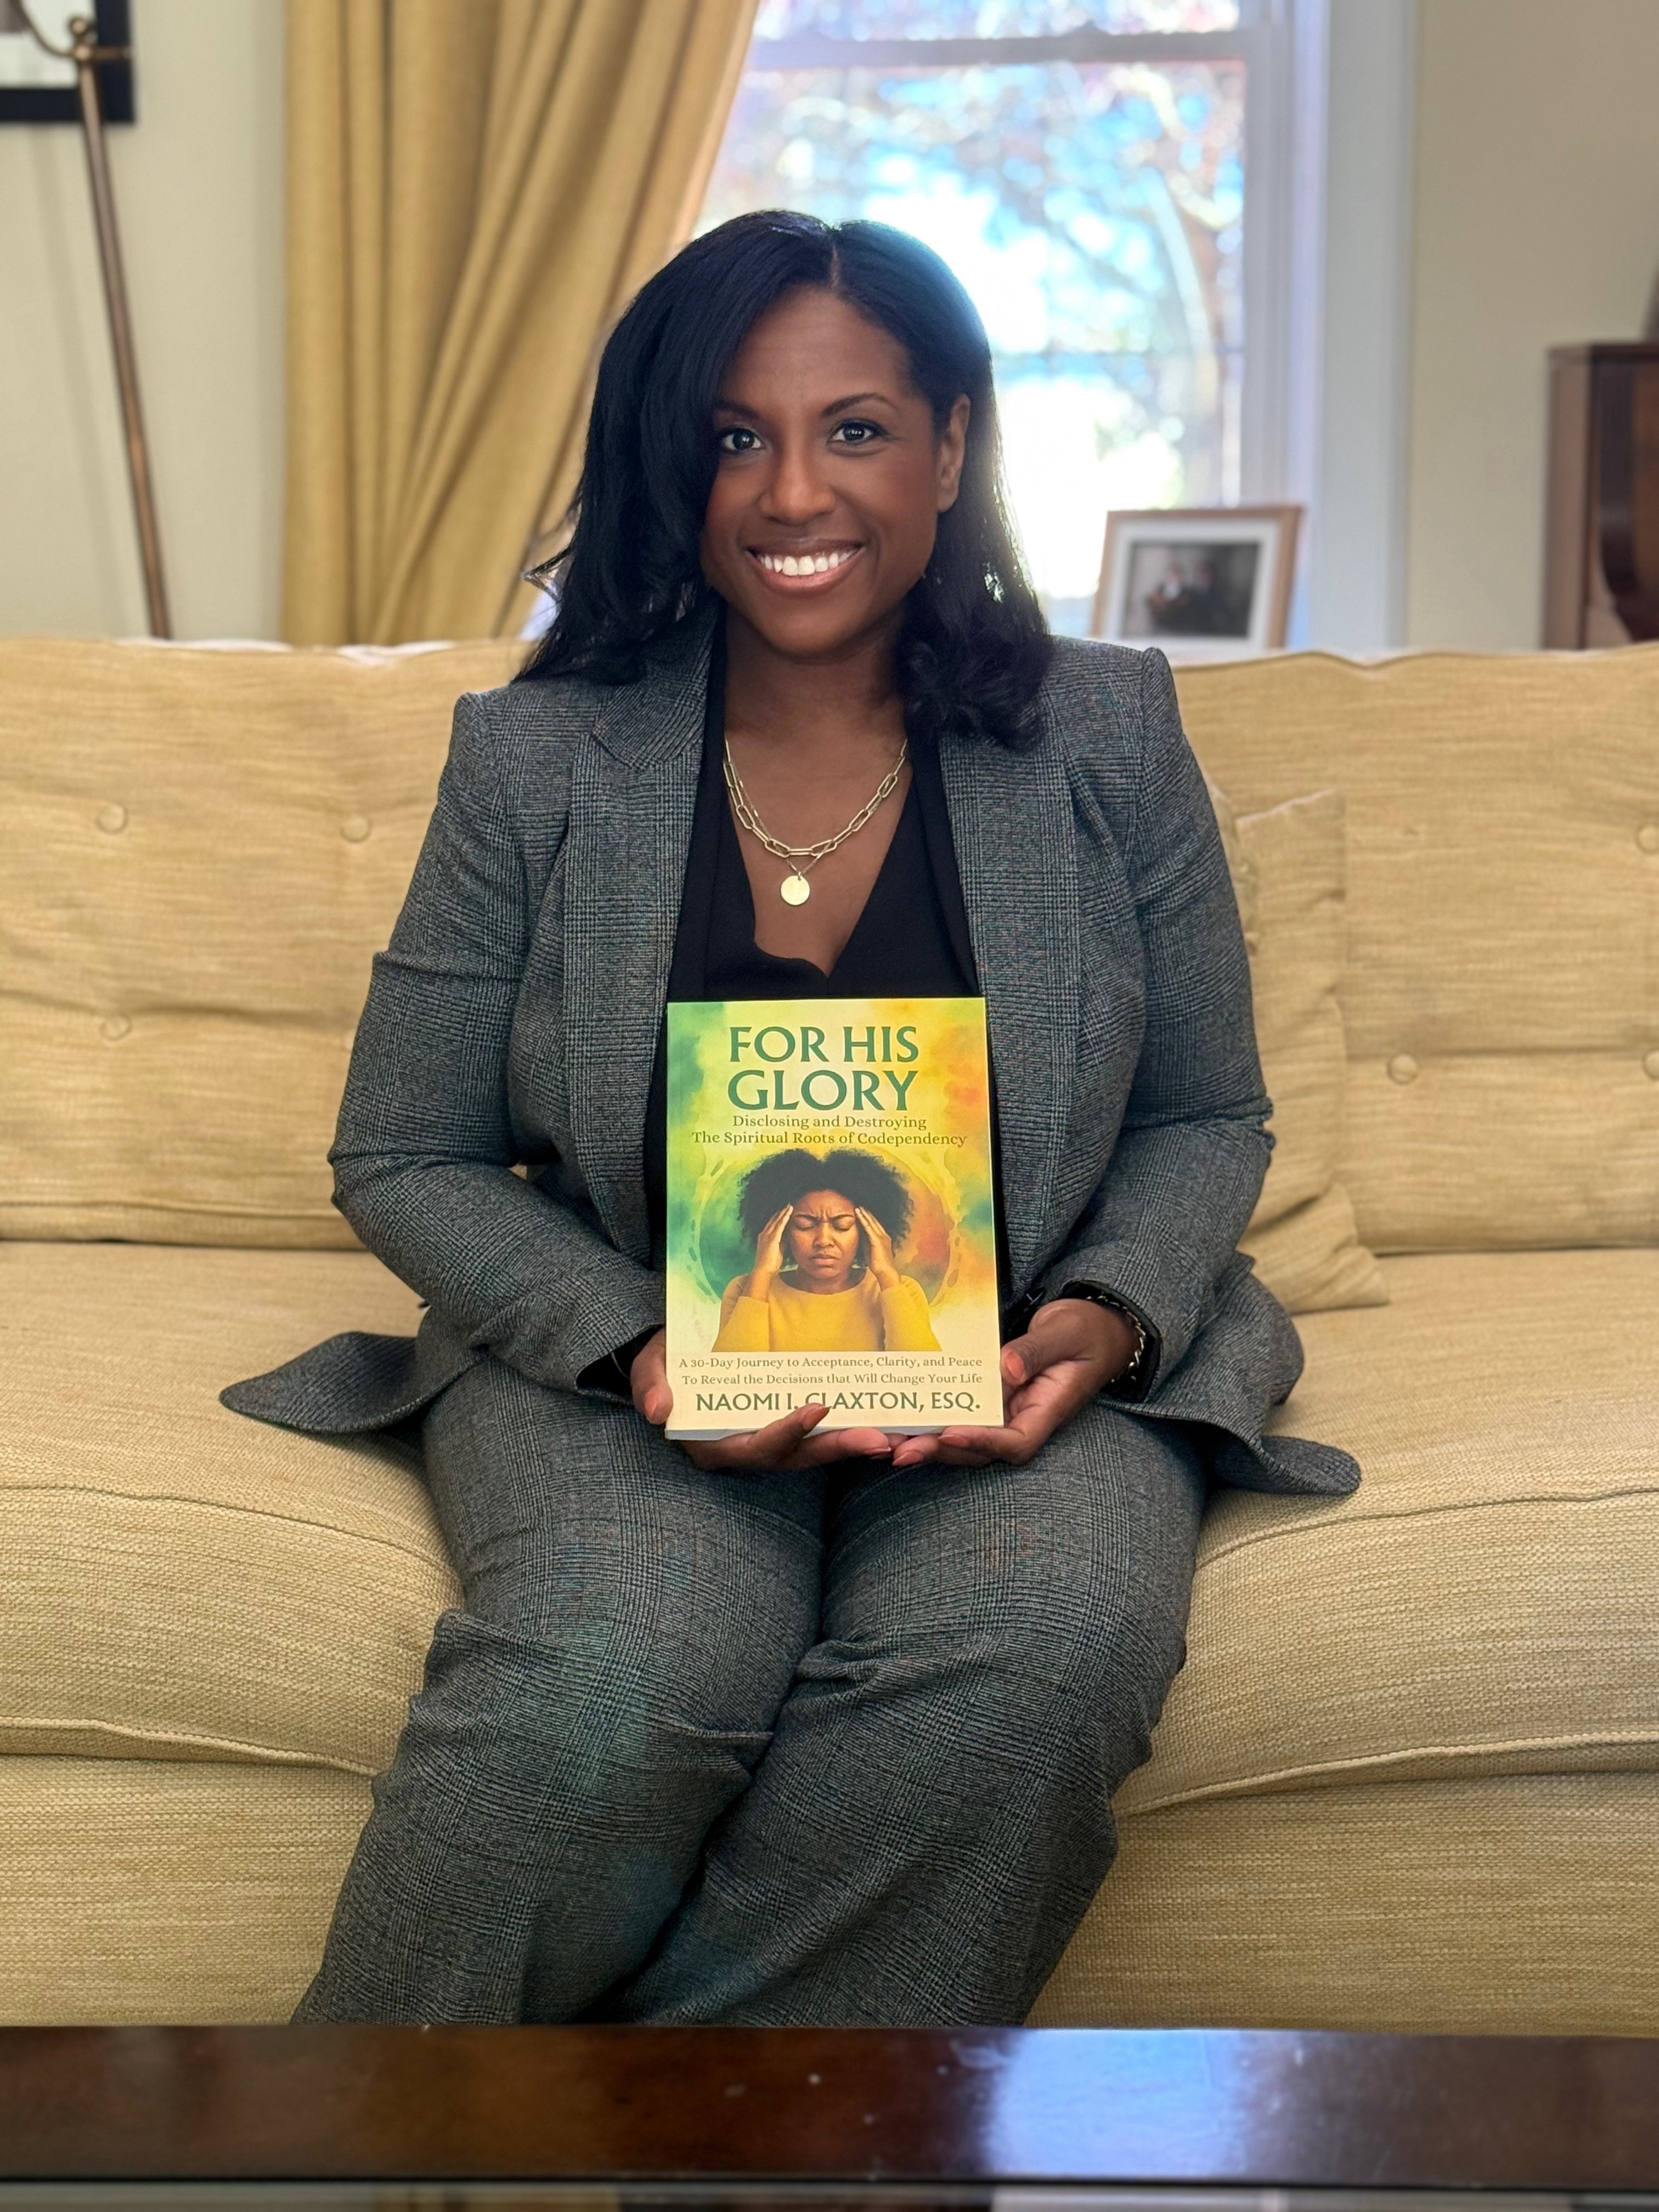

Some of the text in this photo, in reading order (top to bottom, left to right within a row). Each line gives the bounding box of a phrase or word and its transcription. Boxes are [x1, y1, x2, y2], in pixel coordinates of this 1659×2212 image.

[729, 1026, 919, 1063] FOR HIS
[727, 1069, 919, 1111] GLORY
[733, 1115, 927, 1131] Disclosing and Destroying
[692, 1132, 967, 1147] The Spiritual Roots of Codependency
[679, 1357, 982, 1370] A 30-Day Journey to Acceptance, Clarity, and Peace
[682, 1373, 983, 1386] To Reveal the Decisions that Will Change Your Life
[696, 1393, 780, 1411] NAOMI
[787, 1393, 799, 1410] I.
[931, 1392, 980, 1413] ESQ.
